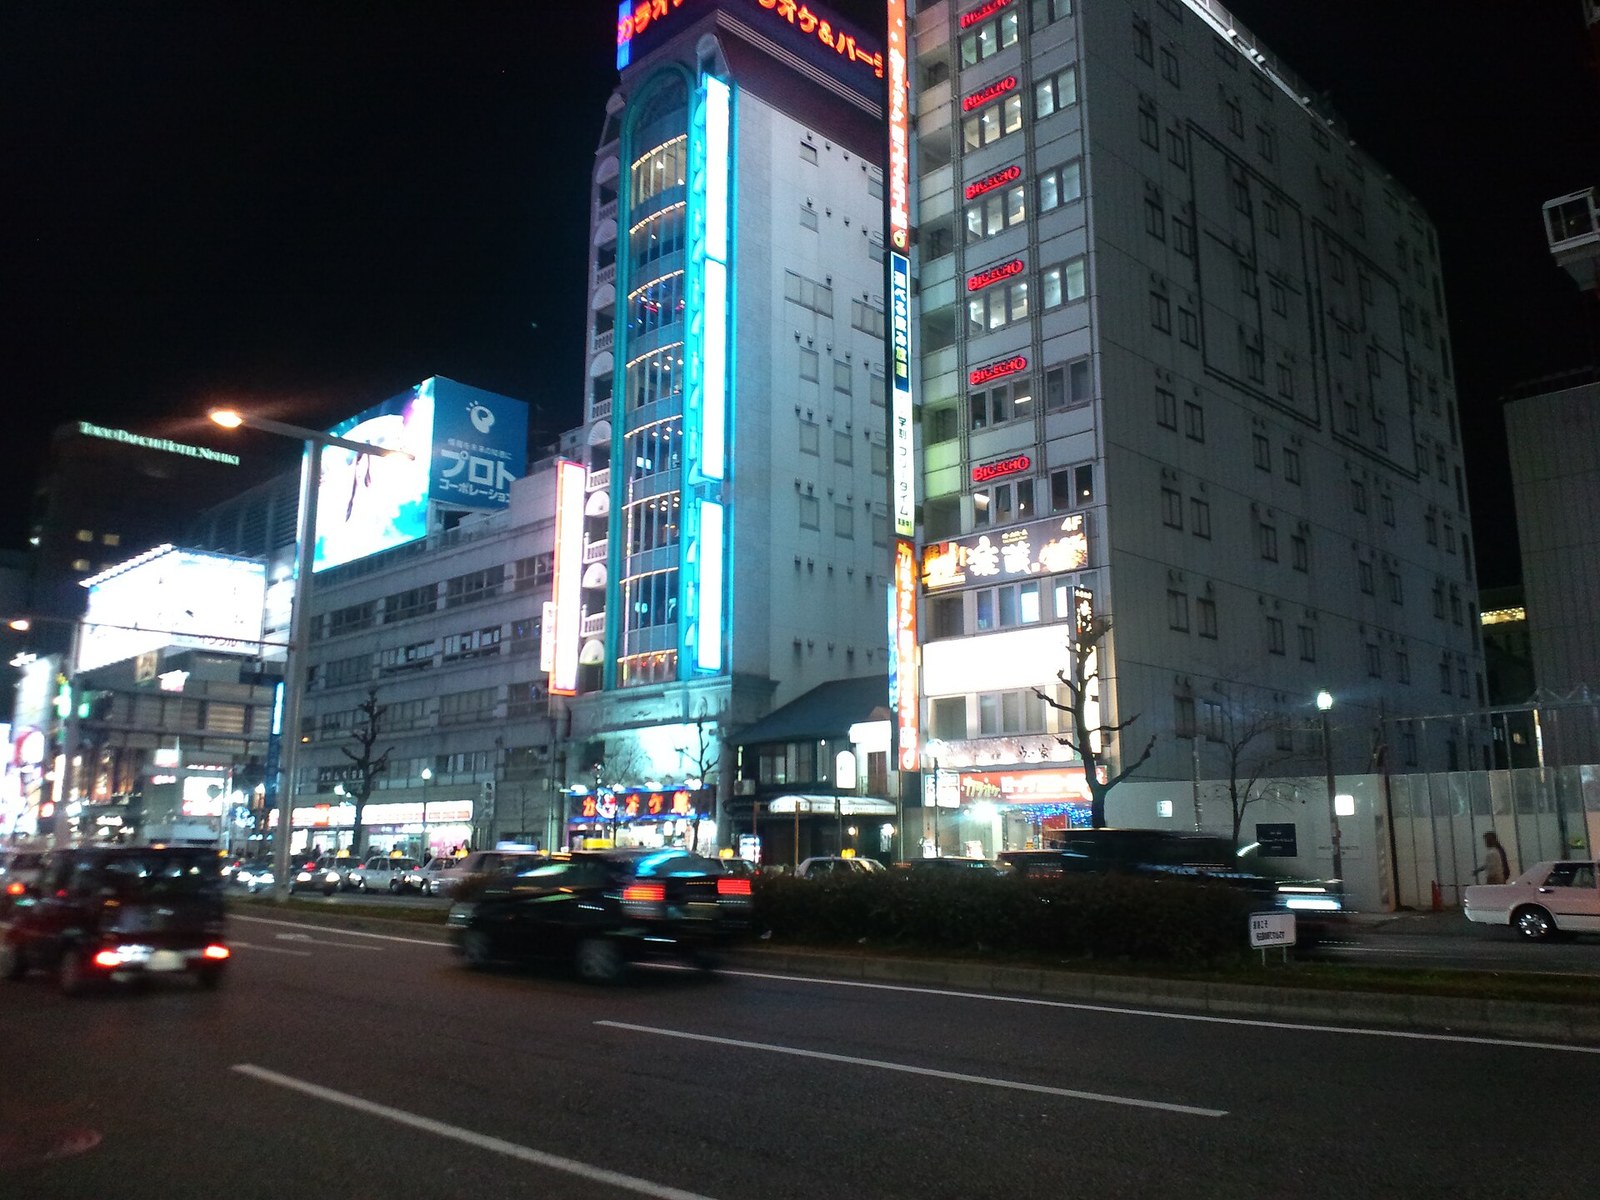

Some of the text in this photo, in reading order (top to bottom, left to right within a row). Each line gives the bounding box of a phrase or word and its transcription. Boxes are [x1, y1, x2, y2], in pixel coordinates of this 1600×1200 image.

[440, 448, 517, 490] プロト
[1061, 514, 1083, 532] 4F
